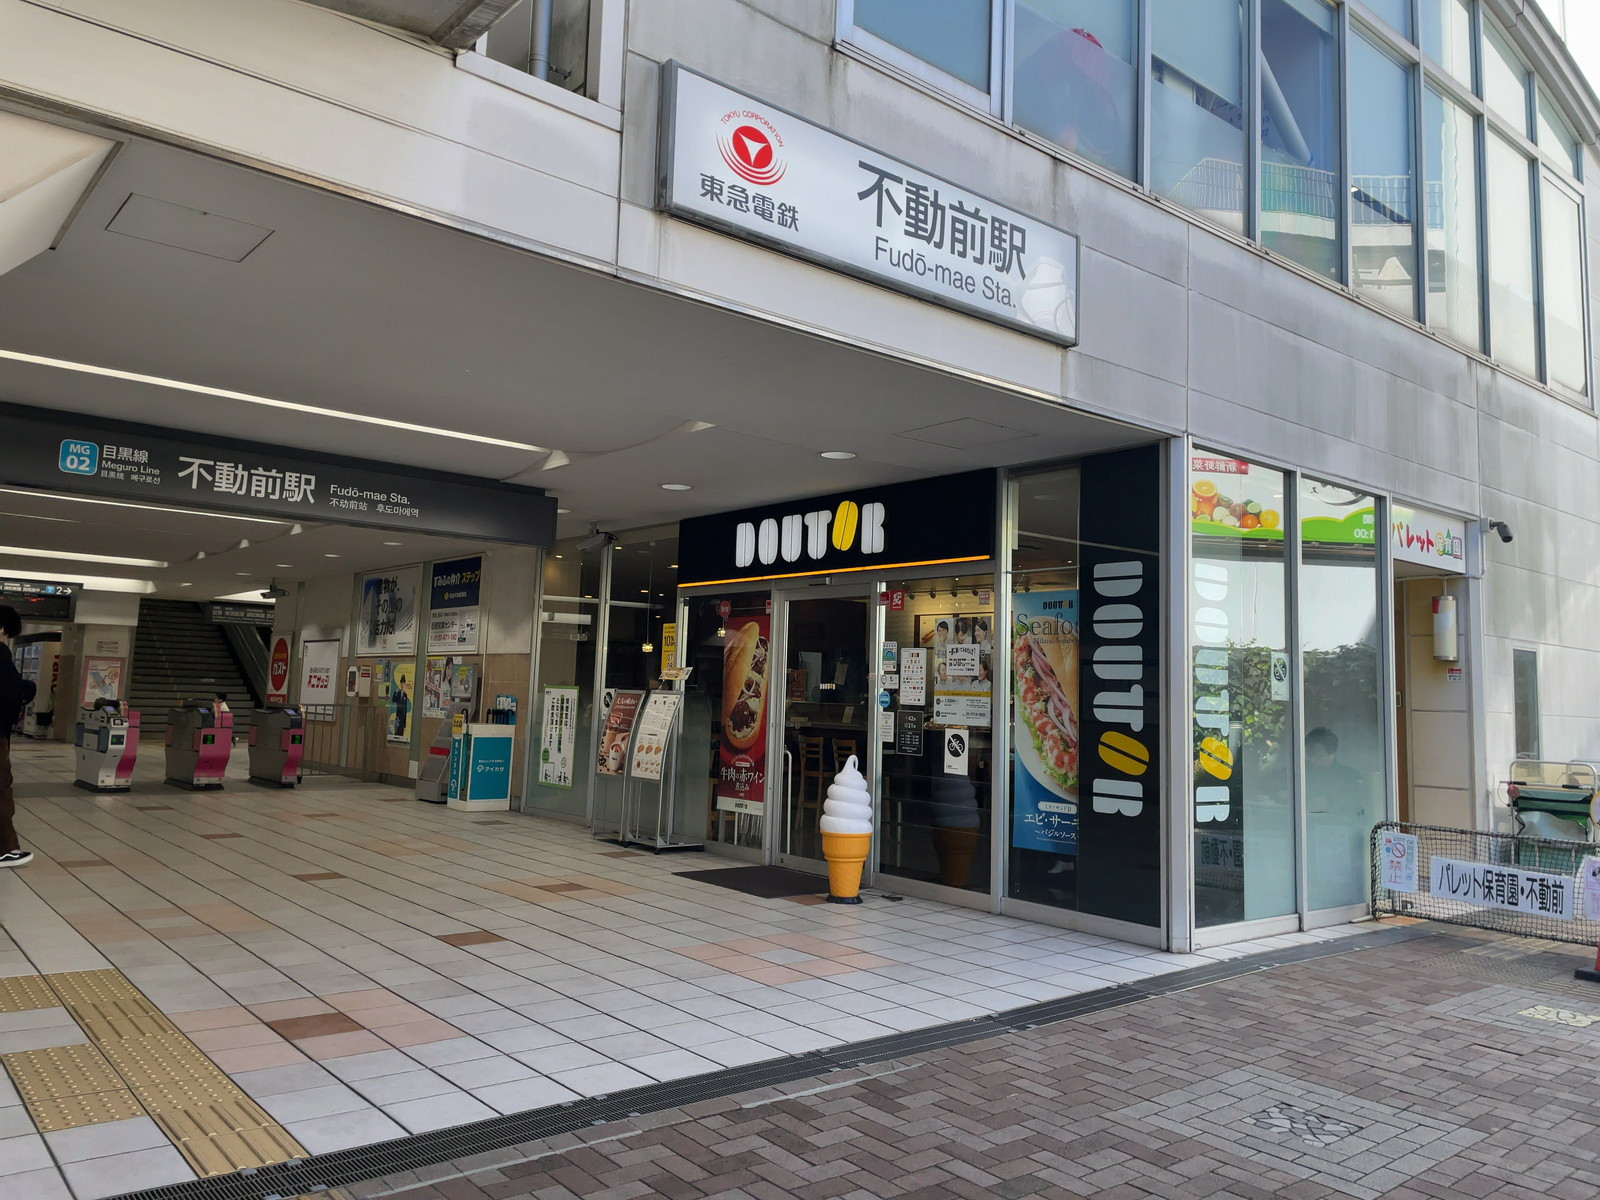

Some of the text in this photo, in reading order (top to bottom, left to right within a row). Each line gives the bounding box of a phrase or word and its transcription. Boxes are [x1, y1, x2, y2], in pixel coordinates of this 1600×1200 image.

[720, 110, 784, 147] TOKYU CORPORATION
[699, 173, 799, 232] 東急電鉄
[857, 160, 1027, 280] 不動前駅
[875, 235, 1016, 309] Fudō-mae Sta.
[69, 443, 91, 455] MG
[102, 444, 149, 463] 目黒線
[66, 455, 91, 471] 02
[101, 460, 161, 476] Meguro Line
[177, 456, 316, 504] 不動前駅
[329, 497, 368, 511] 不动前站
[330, 484, 411, 505] Fudō-mae Sta.
[735, 500, 886, 568] DOUTOR
[1392, 520, 1464, 560] パレット保育園
[461, 570, 481, 584] ステップ
[55, 586, 64, 595] 2
[1043, 600, 1074, 610] DOUTOR
[272, 661, 287, 675] ガスト
[1092, 560, 1150, 818] DOUTOR
[1194, 562, 1235, 823] DOUTOR
[720, 766, 766, 784] 牛肉の赤ワイン
[1438, 863, 1565, 915] パレット保育園・不動前
